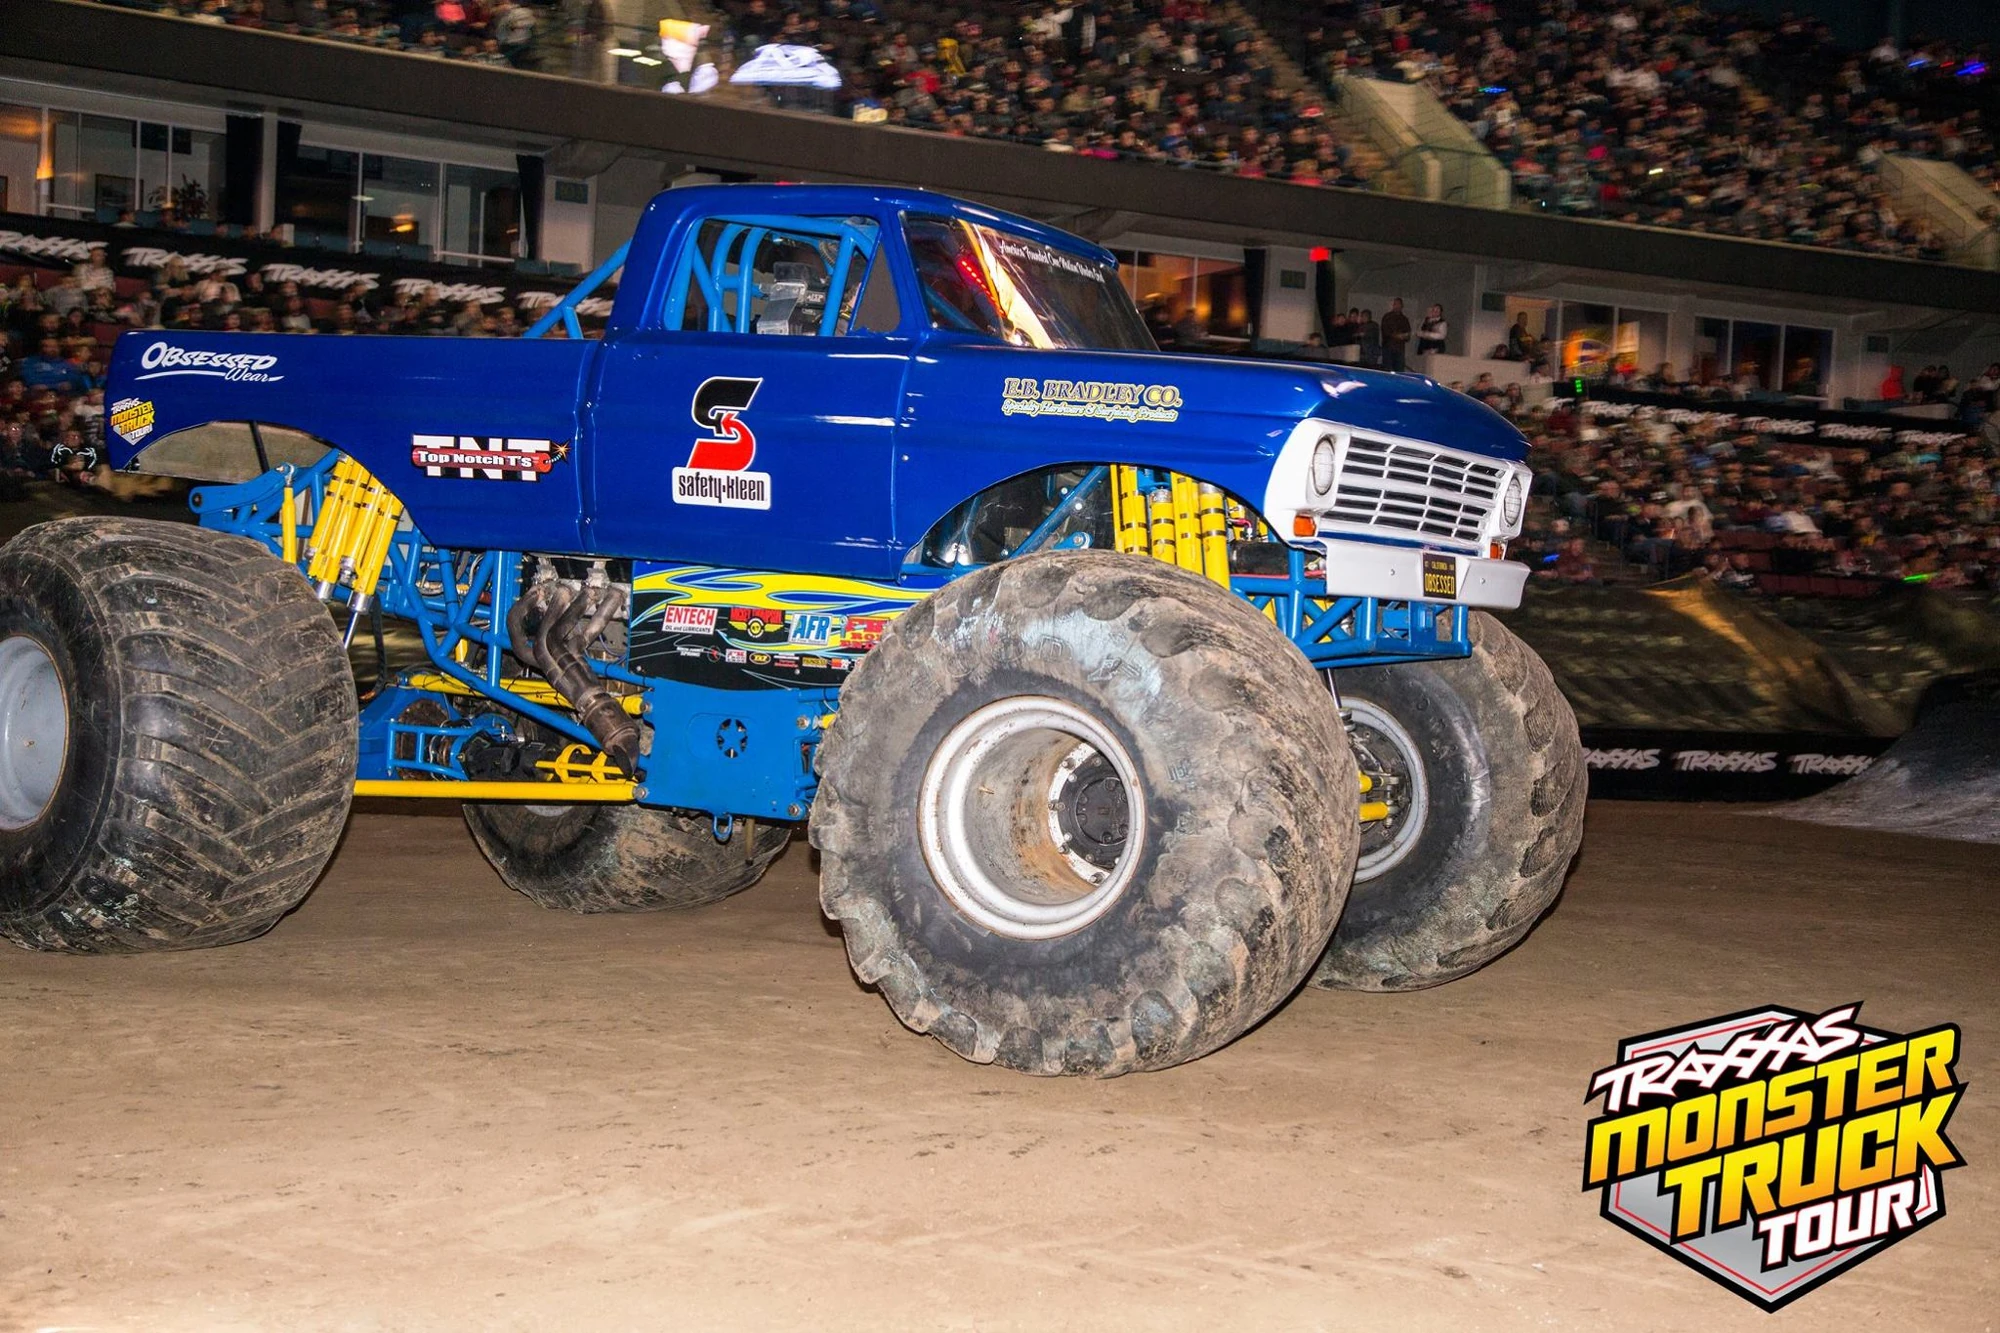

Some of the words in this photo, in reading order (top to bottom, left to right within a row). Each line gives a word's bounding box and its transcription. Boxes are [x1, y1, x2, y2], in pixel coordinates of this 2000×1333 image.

[225, 367, 276, 382] Wear
[1004, 378, 1039, 398] E.B.
[1043, 380, 1144, 404] BRADLEY
[1144, 386, 1183, 406] CO.
[110, 401, 154, 426] MONSTER
[119, 411, 155, 435] TRUCK
[418, 450, 450, 464] Top
[453, 453, 505, 465] Notch
[507, 455, 533, 468] T's
[1425, 573, 1455, 595] OBSESSED
[666, 607, 716, 626] ENTECH
[792, 615, 830, 640] AFR
[1675, 751, 1778, 773] TRAXXAS
